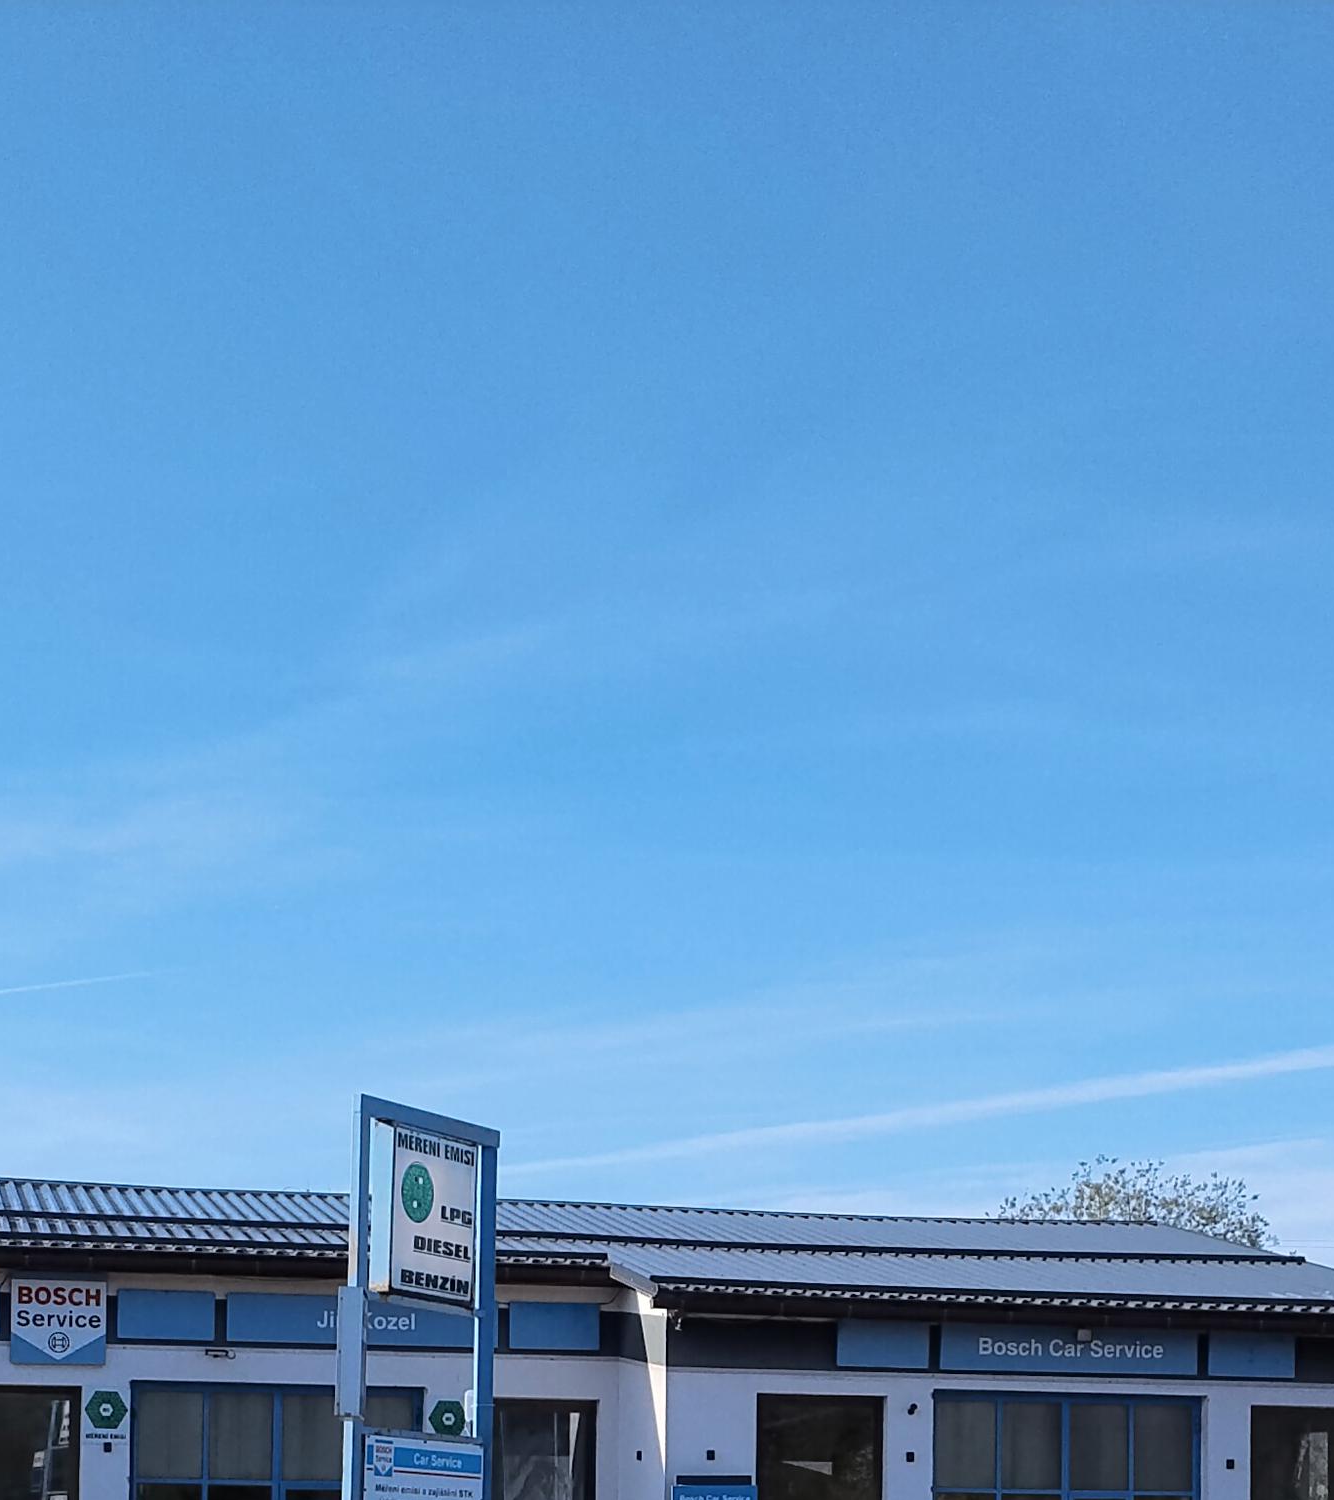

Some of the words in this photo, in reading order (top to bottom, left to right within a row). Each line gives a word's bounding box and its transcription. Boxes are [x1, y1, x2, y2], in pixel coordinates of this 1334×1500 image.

[440, 1205, 473, 1226] LPG
[413, 1235, 471, 1261] DIESEL
[400, 1268, 470, 1295] BENZÍN
[17, 1285, 101, 1307] BOSCH
[16, 1309, 102, 1329] Service
[316, 1310, 336, 1329] Ji
[978, 1336, 1043, 1357] Bosch
[1049, 1338, 1084, 1358] Car
[1090, 1339, 1164, 1359] Service
[413, 1452, 429, 1466] Car
[431, 1454, 463, 1470] Service
[458, 1489, 474, 1498] STK
